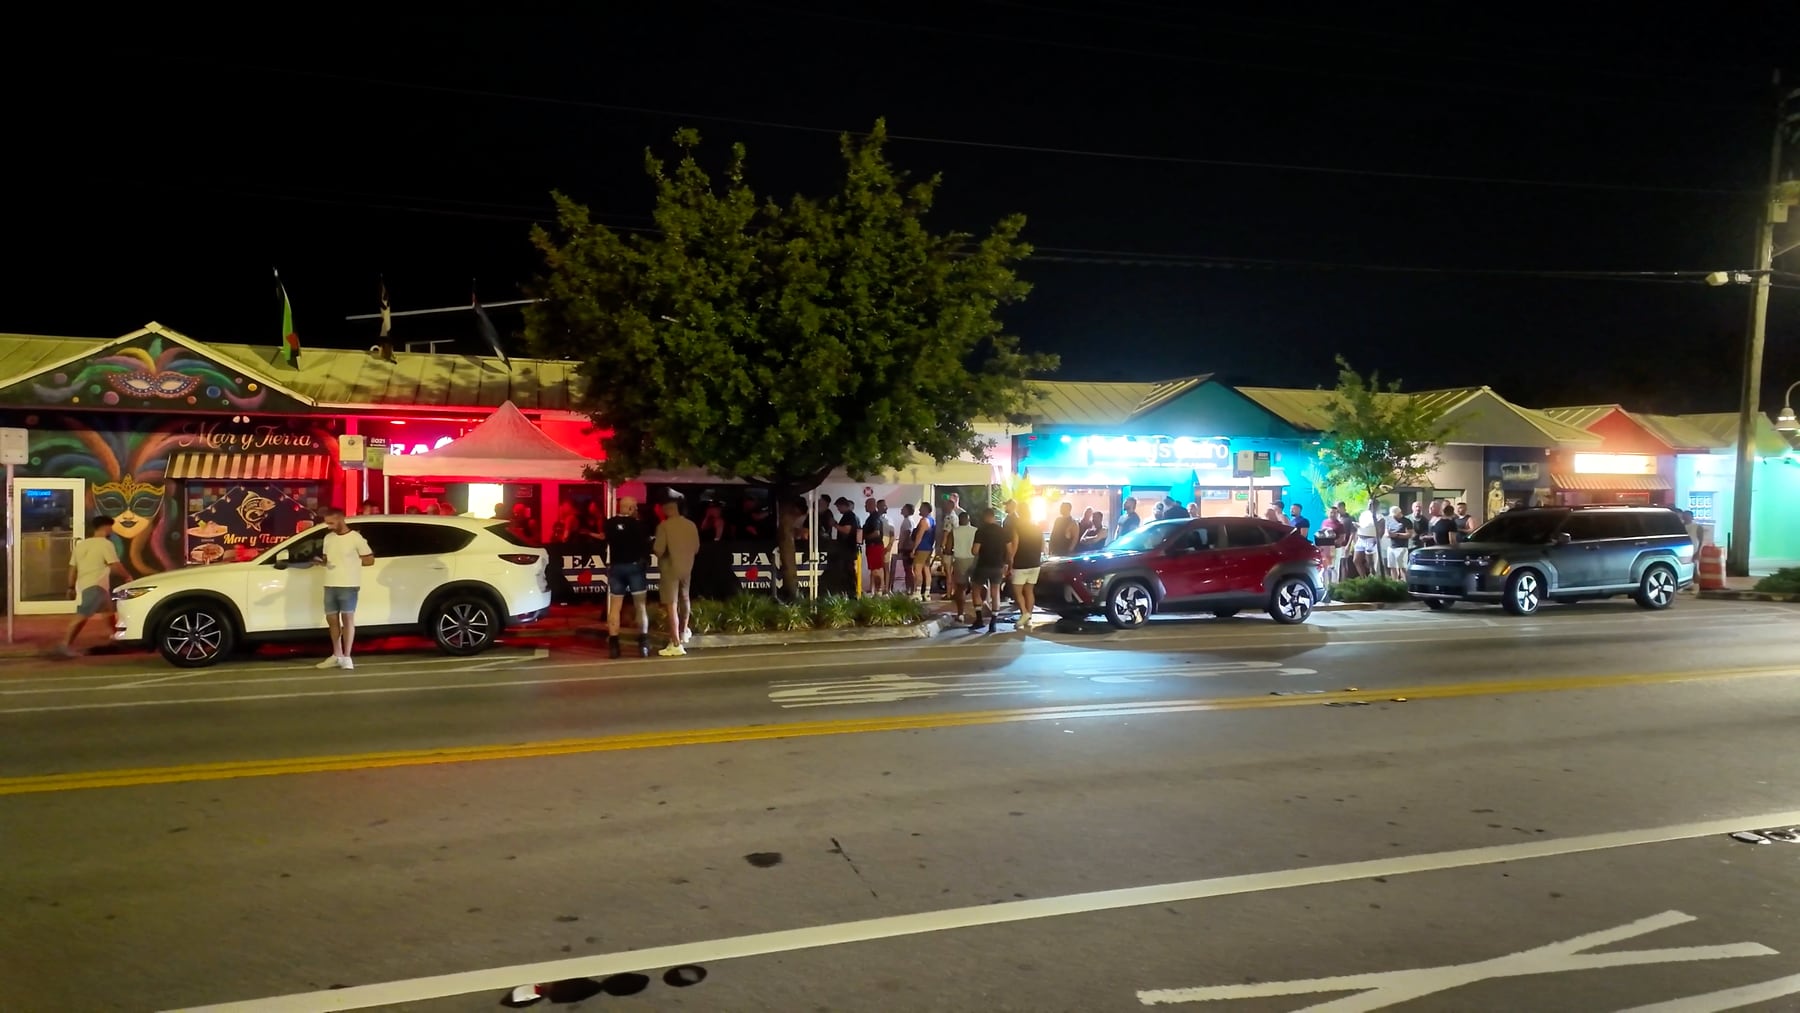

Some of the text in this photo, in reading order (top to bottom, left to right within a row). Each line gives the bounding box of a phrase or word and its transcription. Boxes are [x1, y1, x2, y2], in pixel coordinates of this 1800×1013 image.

[179, 421, 312, 450] Mar y Tierra
[223, 533, 290, 547] Mar y Tierr
[572, 584, 607, 593] WILTON
[741, 581, 771, 589] WILTON
